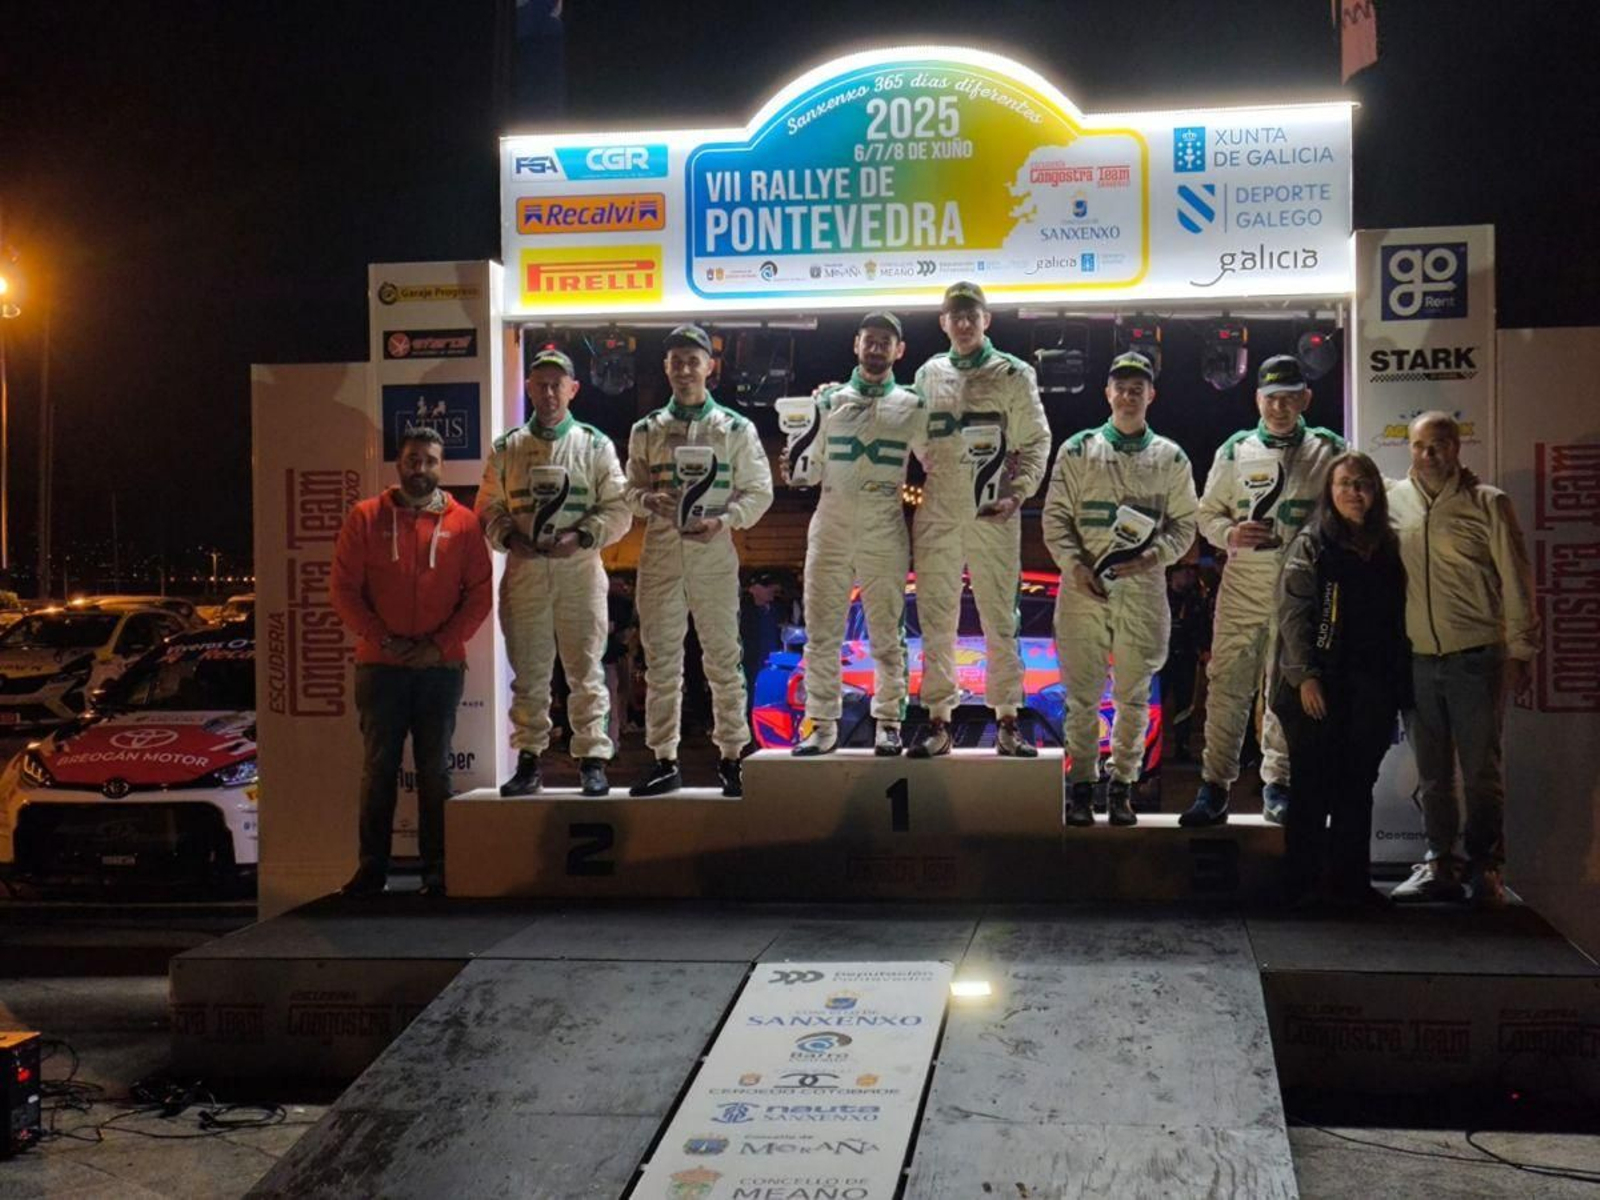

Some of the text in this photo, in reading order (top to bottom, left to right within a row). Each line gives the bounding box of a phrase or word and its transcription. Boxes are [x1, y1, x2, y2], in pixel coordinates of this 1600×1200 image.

[787, 85, 871, 135] Sanxenxo
[873, 73, 904, 93] 365
[955, 76, 1044, 125] diferentes
[866, 96, 960, 140] 2025
[1214, 127, 1288, 146] XUNTA
[585, 146, 650, 172] CGR
[853, 137, 974, 162] 6/7/8 DE XUÑO
[1213, 146, 1334, 167] DE GALICIA
[515, 155, 558, 174] FSA
[1030, 164, 1131, 188] Congostra Team
[705, 166, 896, 203] VII RALLYE DE
[1235, 183, 1332, 204] DEPORTE
[545, 200, 637, 226] Recalvi
[1235, 208, 1323, 229] GALEGO
[705, 200, 965, 252] PONTEVEDRA
[1039, 225, 1121, 241] SANXENXO
[526, 259, 656, 292] PIRELLI
[1024, 255, 1077, 275] galicia
[1190, 243, 1319, 287] galicia
[1388, 248, 1458, 317] go
[1369, 347, 1476, 372] STARK
[801, 455, 809, 473] 1
[986, 482, 996, 500] 1
[286, 468, 344, 550] Team
[269, 611, 286, 715] ESCUDERIA
[142, 751, 210, 767] MOTOR
[886, 778, 909, 832] 1
[566, 823, 614, 876] 2
[1190, 838, 1238, 893] 3
[746, 1015, 923, 1026] SANXENXO
[763, 1114, 878, 1122] SANXENXO
[765, 1105, 881, 1113] nauta
